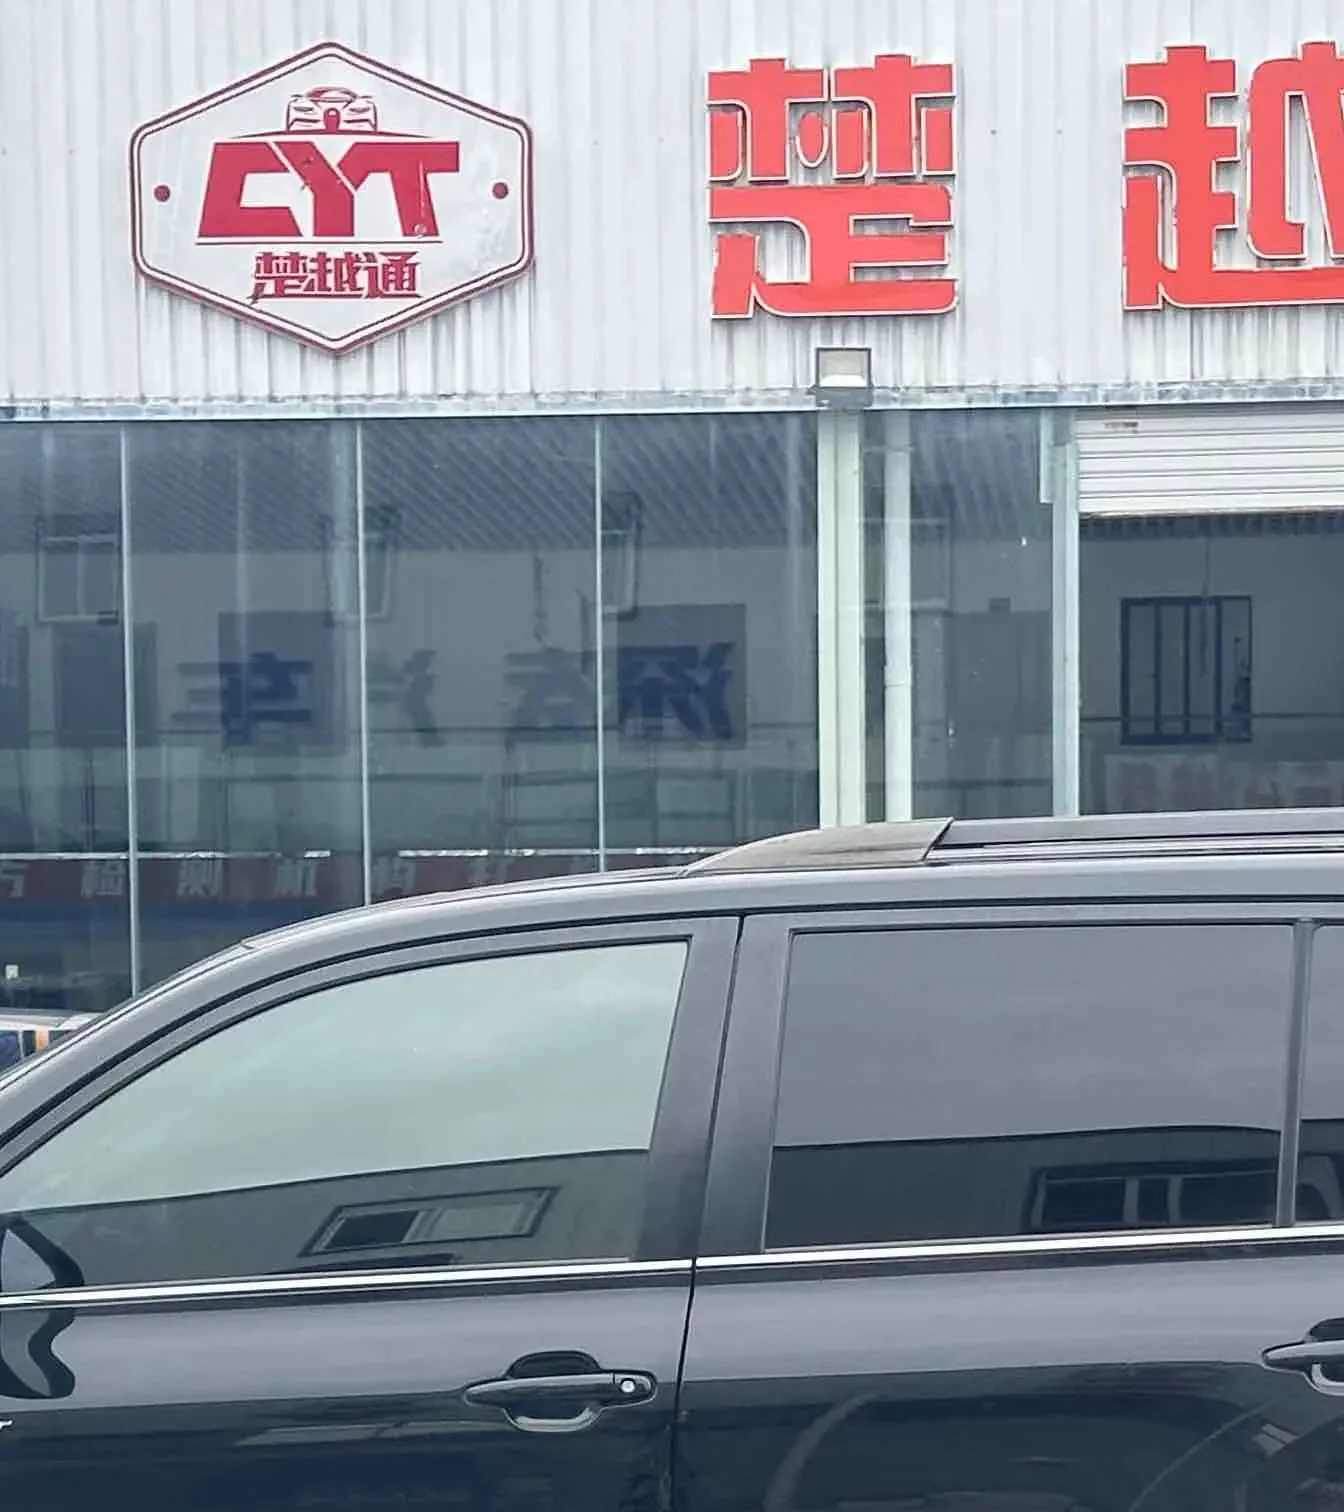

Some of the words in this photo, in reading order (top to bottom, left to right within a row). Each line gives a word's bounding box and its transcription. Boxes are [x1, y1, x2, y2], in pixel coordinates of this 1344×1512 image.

[197, 140, 461, 238] CYT
[248, 250, 420, 304] 楚越通
